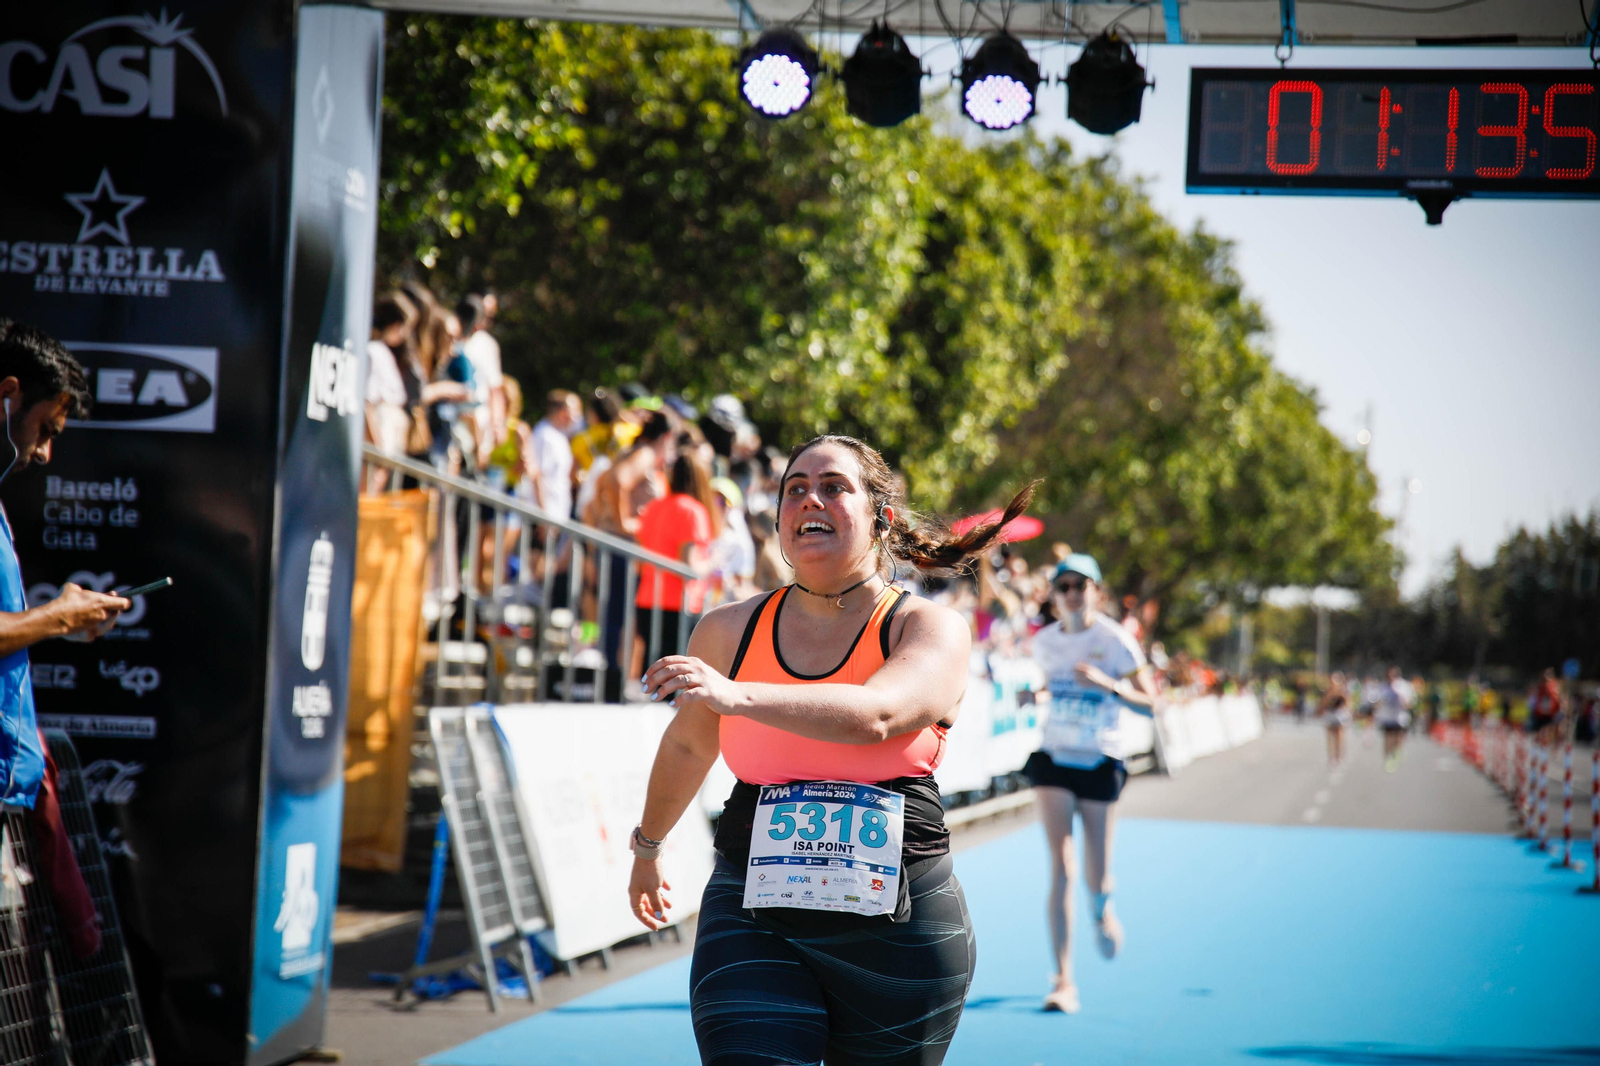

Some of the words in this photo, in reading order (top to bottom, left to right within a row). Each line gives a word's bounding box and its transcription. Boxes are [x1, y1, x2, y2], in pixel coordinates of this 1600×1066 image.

[0, 40, 177, 119] CASI
[0, 241, 226, 283] STRELLA
[35, 274, 65, 293] DE
[68, 276, 171, 298] LEVANTE
[83, 366, 190, 407] EA
[46, 475, 137, 501] Barceló
[44, 500, 103, 526] Cabo
[109, 503, 138, 528] de
[43, 525, 97, 550] Gata
[802, 789, 833, 798] Almería
[833, 790, 856, 799] 2024
[826, 784, 857, 792] Maratón
[767, 802, 888, 848] 5318
[793, 841, 813, 851] ISA
[817, 841, 855, 854] POINT
[786, 875, 812, 885] NEXAL
